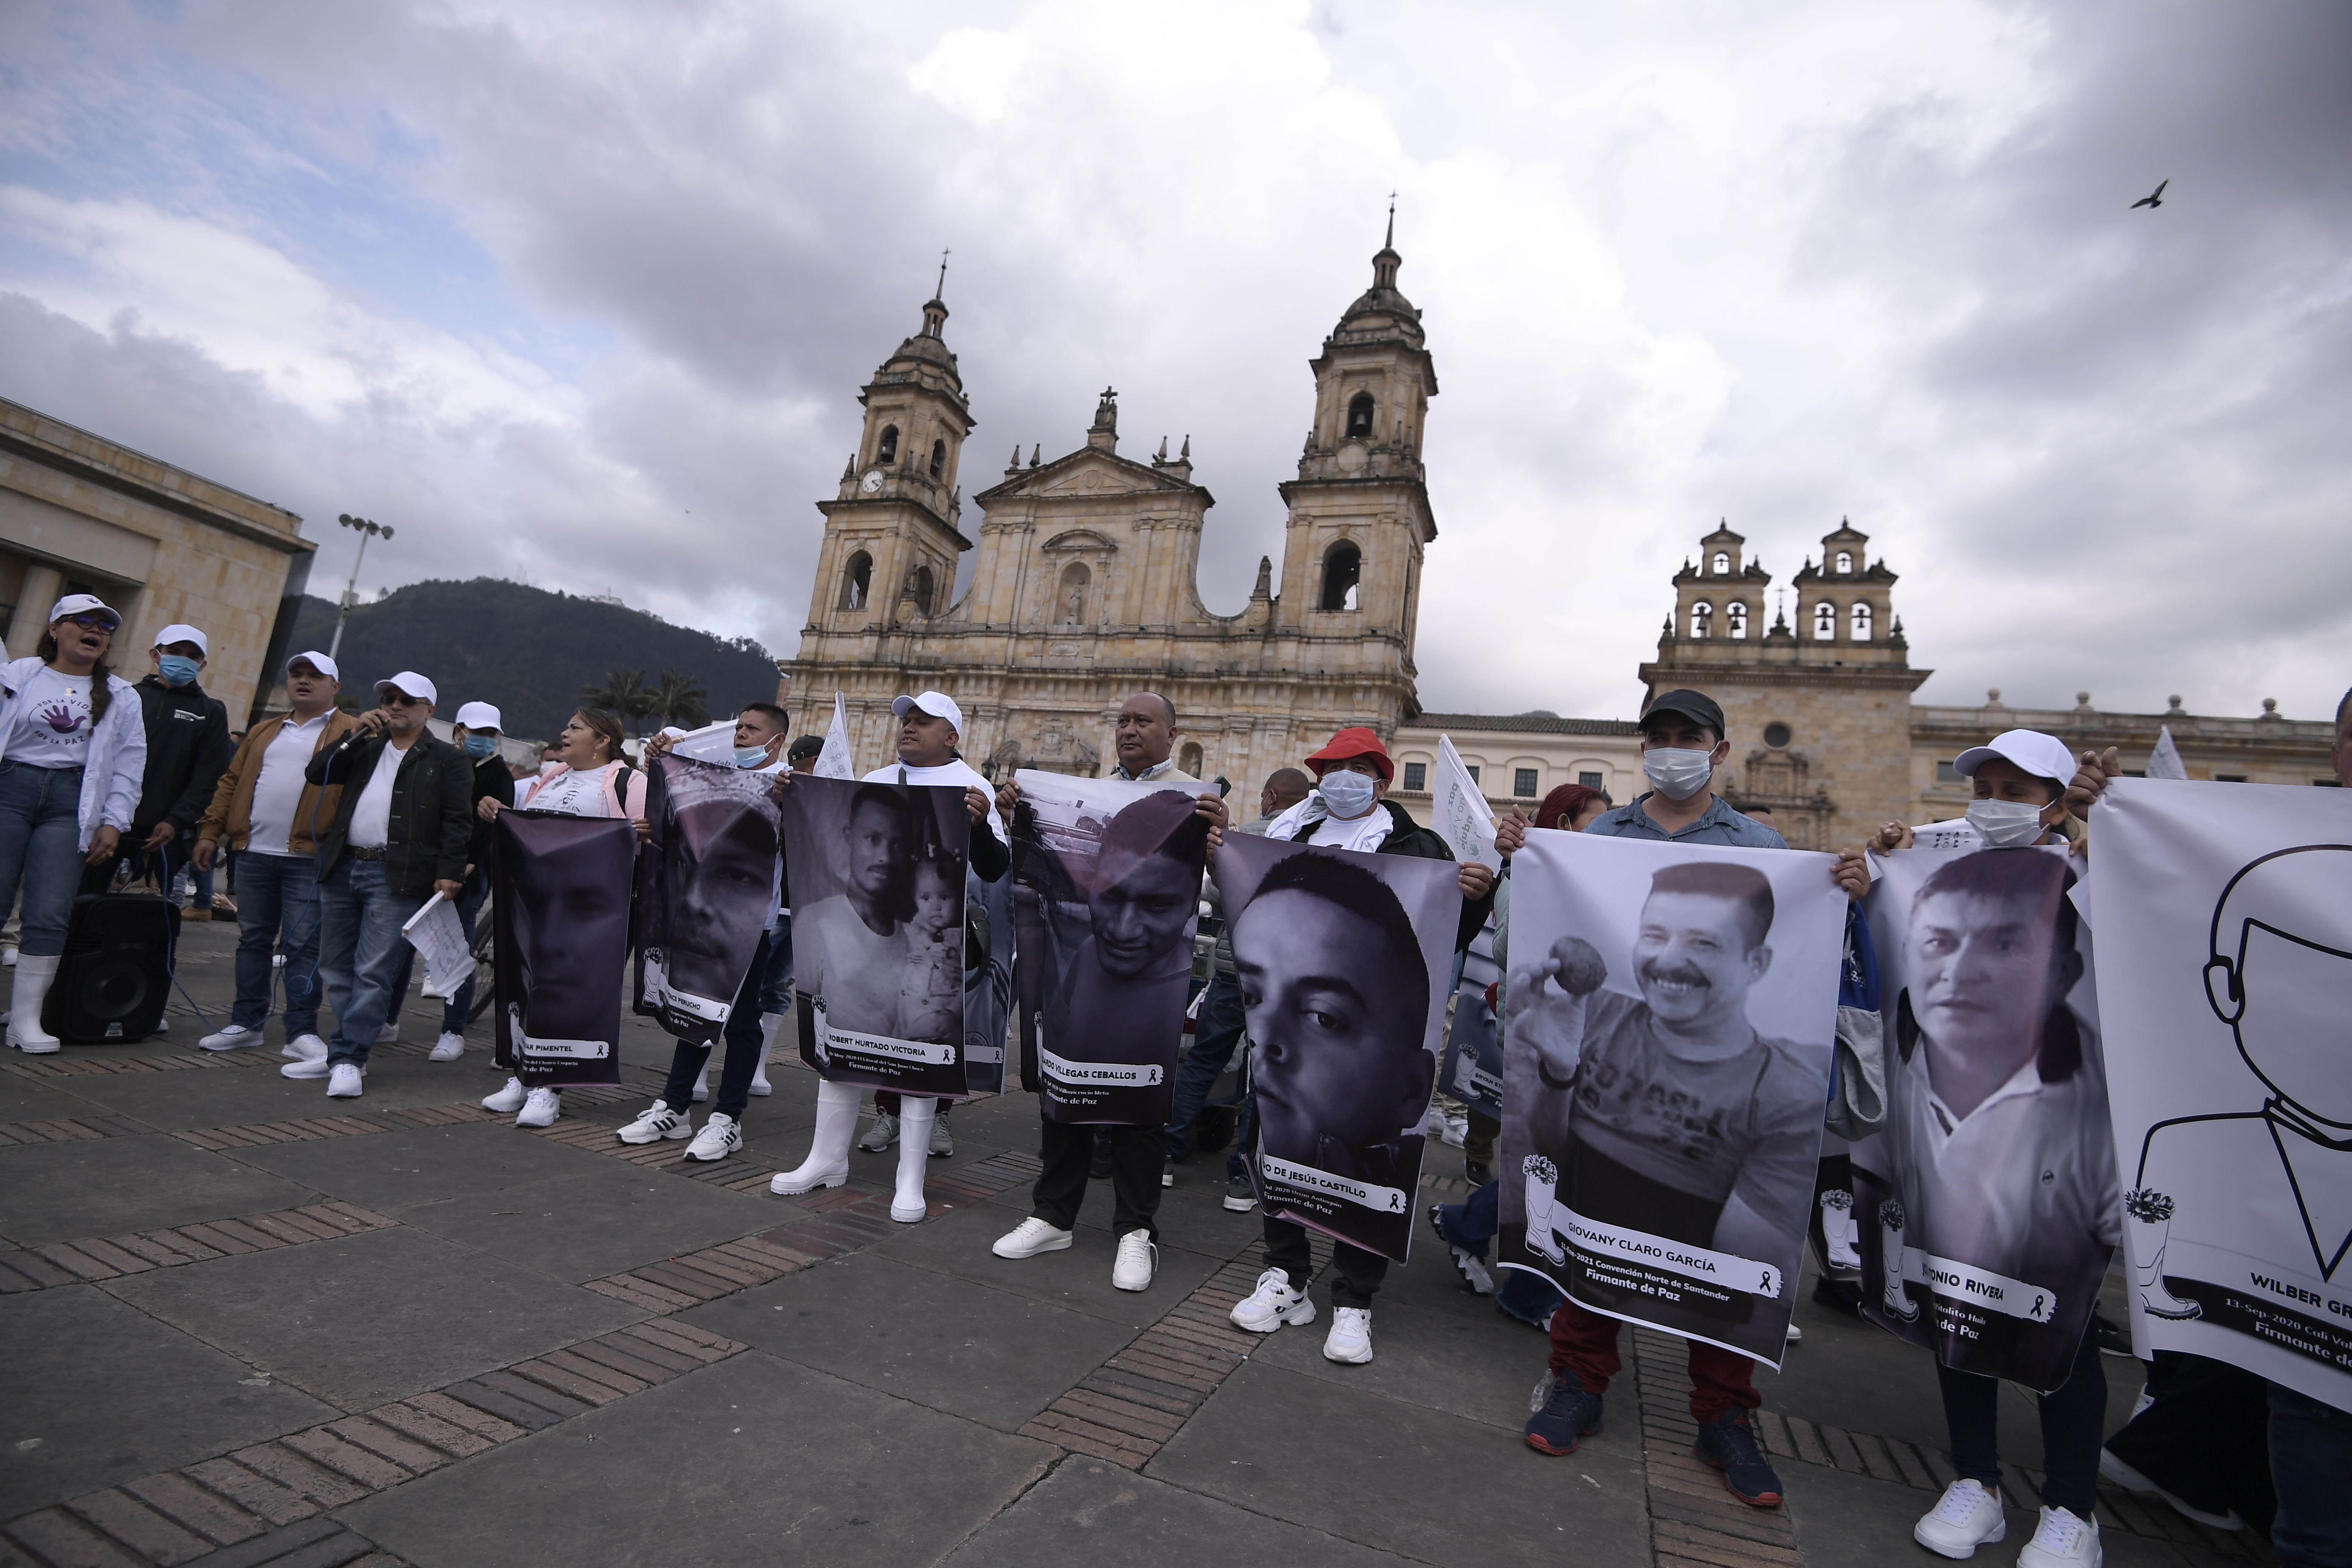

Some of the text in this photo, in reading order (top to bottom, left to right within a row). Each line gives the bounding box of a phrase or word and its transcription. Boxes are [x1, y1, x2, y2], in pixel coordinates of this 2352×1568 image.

[71, 699, 92, 714] VID
[35, 730, 48, 740] POR
[65, 735, 85, 745] PAZ
[678, 997, 700, 1010] PERUCHO
[829, 1034, 926, 1056] ROBERT HURTADO VICTORIA
[849, 1062, 878, 1072] Firmante
[889, 1068, 901, 1076] Paz
[1055, 1064, 1089, 1078] VILLEGAS
[1092, 1070, 1136, 1080] CEBALLOS
[1475, 1073, 1493, 1084] BRYAN
[1059, 1087, 1093, 1095] Villavicencio
[1274, 1166, 1286, 1177] DE
[1288, 1171, 1317, 1185] JESÚS
[1320, 1180, 1366, 1198] CASTILLO
[1264, 1191, 1333, 1215] Firmante de Paz
[1311, 1195, 1342, 1208] Antioquia
[1568, 1222, 1716, 1273] GIOVANY CLARO GARCÍA
[1560, 1241, 1730, 1302] 11-Ene-2021 Convención Norte de Santander
[1586, 1268, 1681, 1302] Firmante de Paz
[1965, 1278, 2004, 1301] RIVERA
[2250, 1272, 2322, 1308] WILBER
[1940, 1319, 1956, 1332] de
[1960, 1325, 1979, 1339] Paz
[2225, 1298, 2301, 1330] 13-Sep-2020
[2304, 1326, 2328, 1341] Cali
[2255, 1320, 2331, 1358] Firmante
